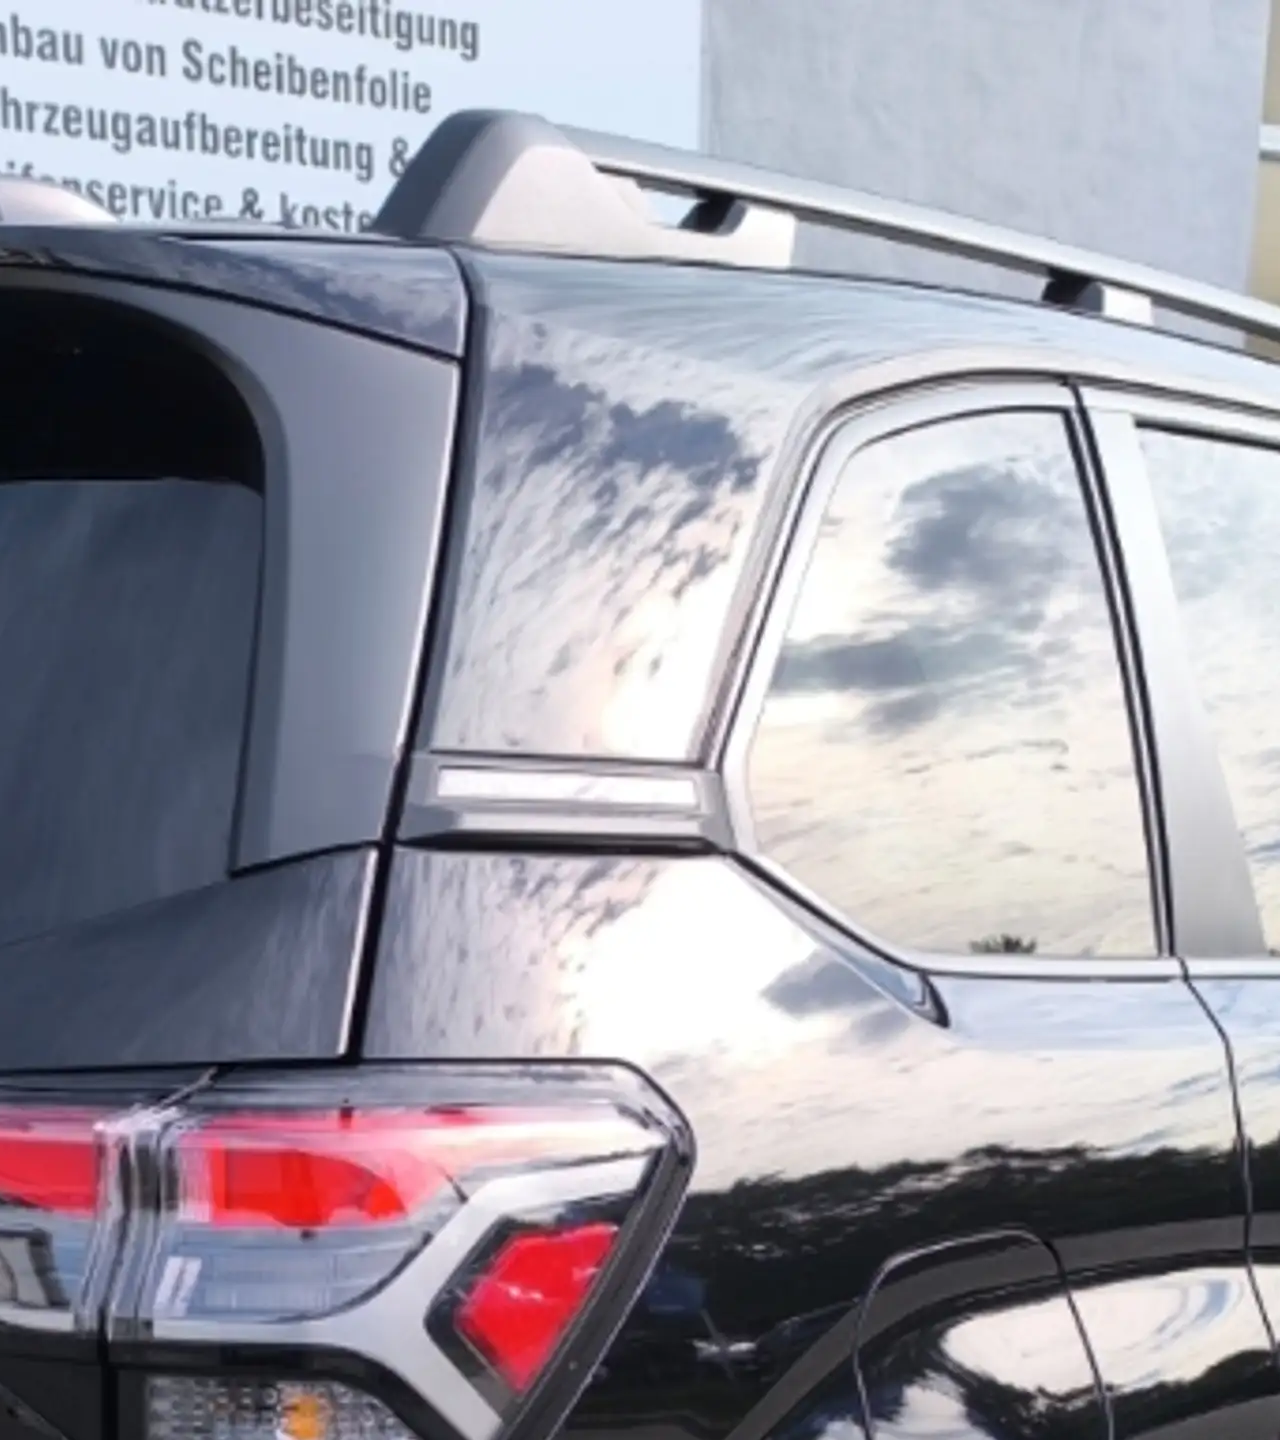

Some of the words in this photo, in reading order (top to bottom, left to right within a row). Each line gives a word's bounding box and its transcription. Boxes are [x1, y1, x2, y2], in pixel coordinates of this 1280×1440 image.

[99, 36, 166, 76] von
[181, 37, 432, 113] Scheibenfolie
[389, 137, 412, 178] &
[239, 187, 264, 220] &
[280, 191, 378, 233] koste
